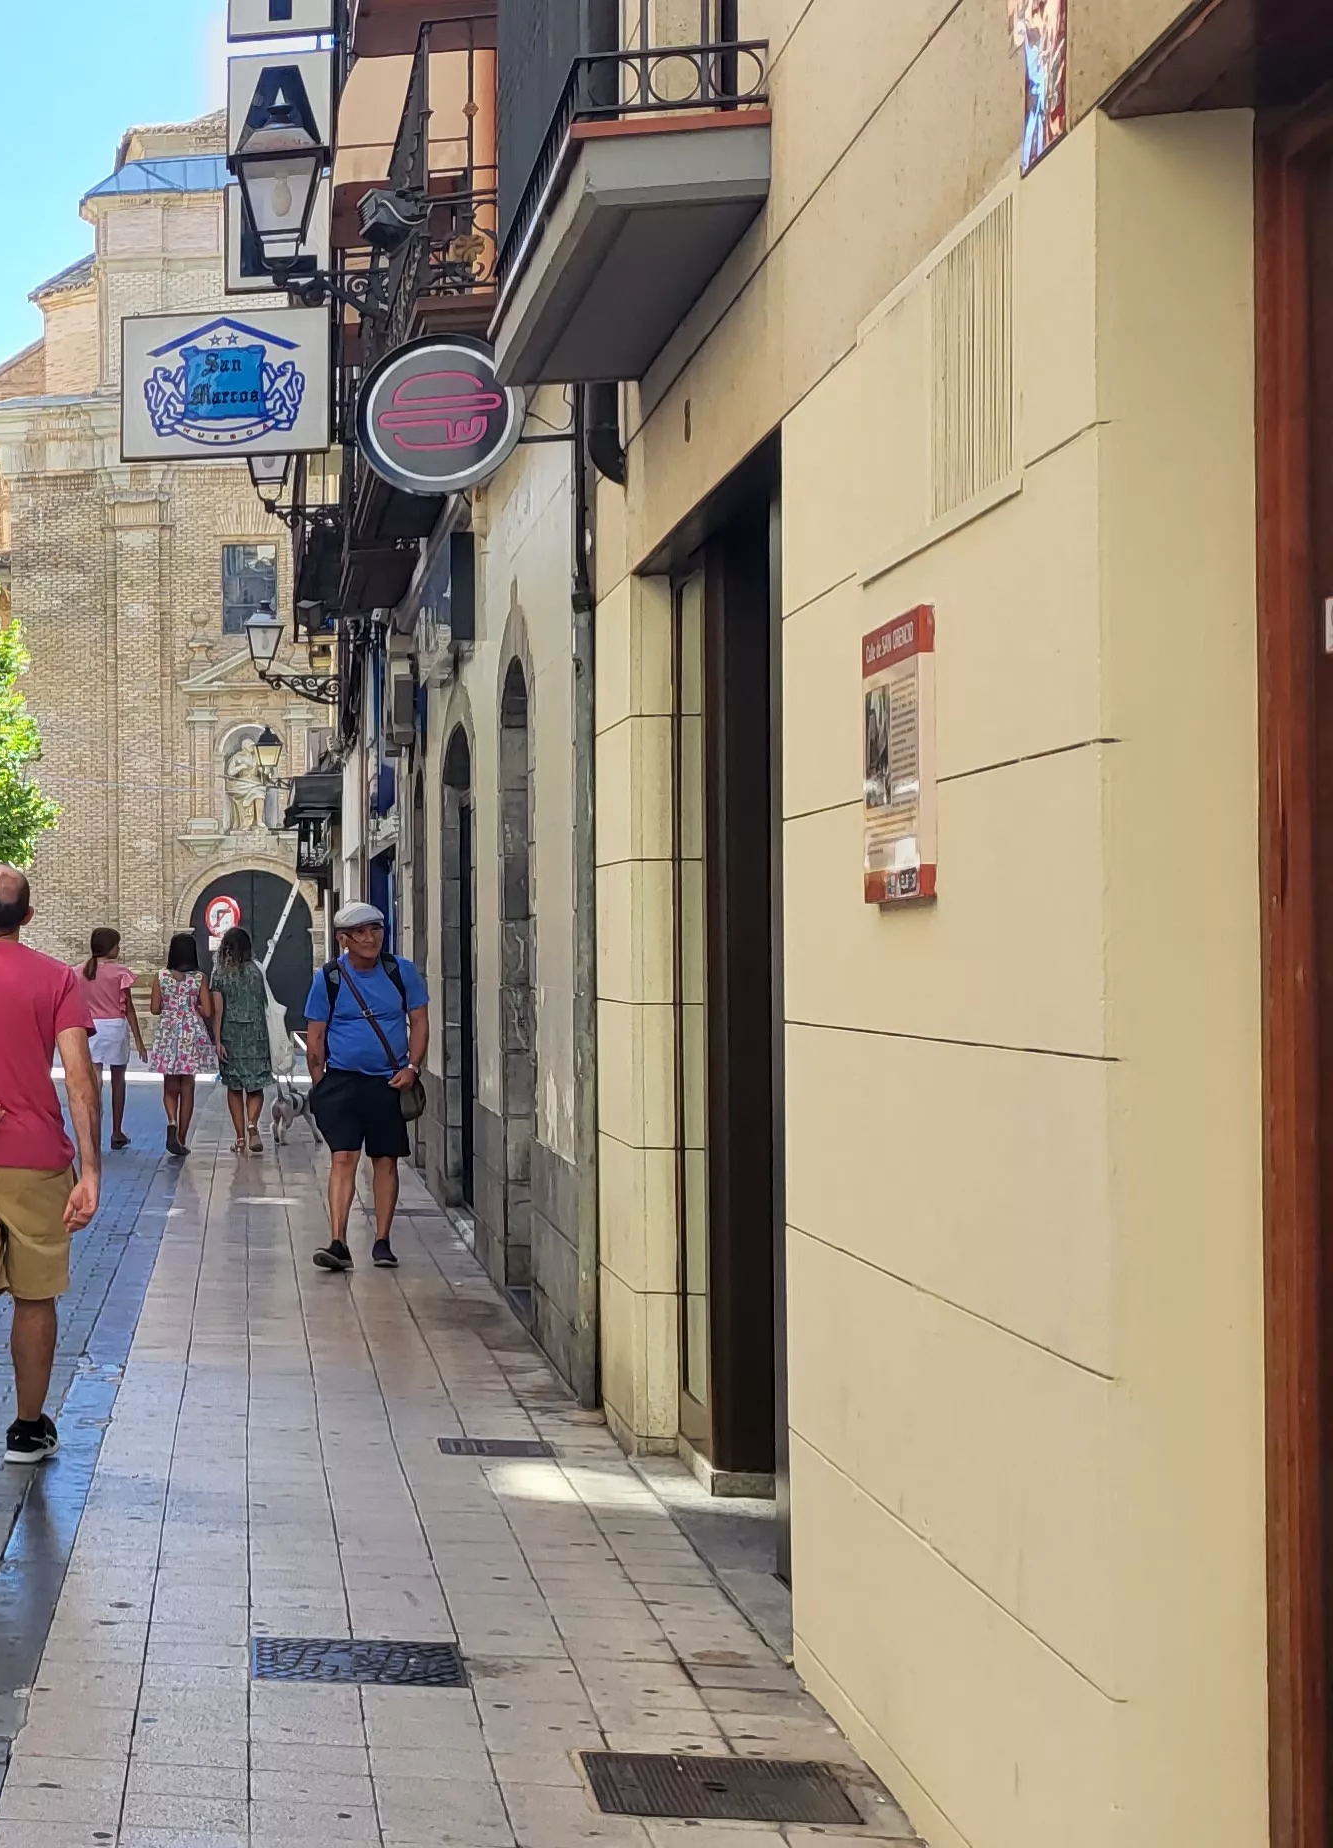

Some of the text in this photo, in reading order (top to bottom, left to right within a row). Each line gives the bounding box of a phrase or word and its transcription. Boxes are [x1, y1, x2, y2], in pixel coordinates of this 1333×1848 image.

[201, 353, 242, 377] San
[188, 383, 260, 406] Marcos
[183, 423, 270, 440] HUESCA
